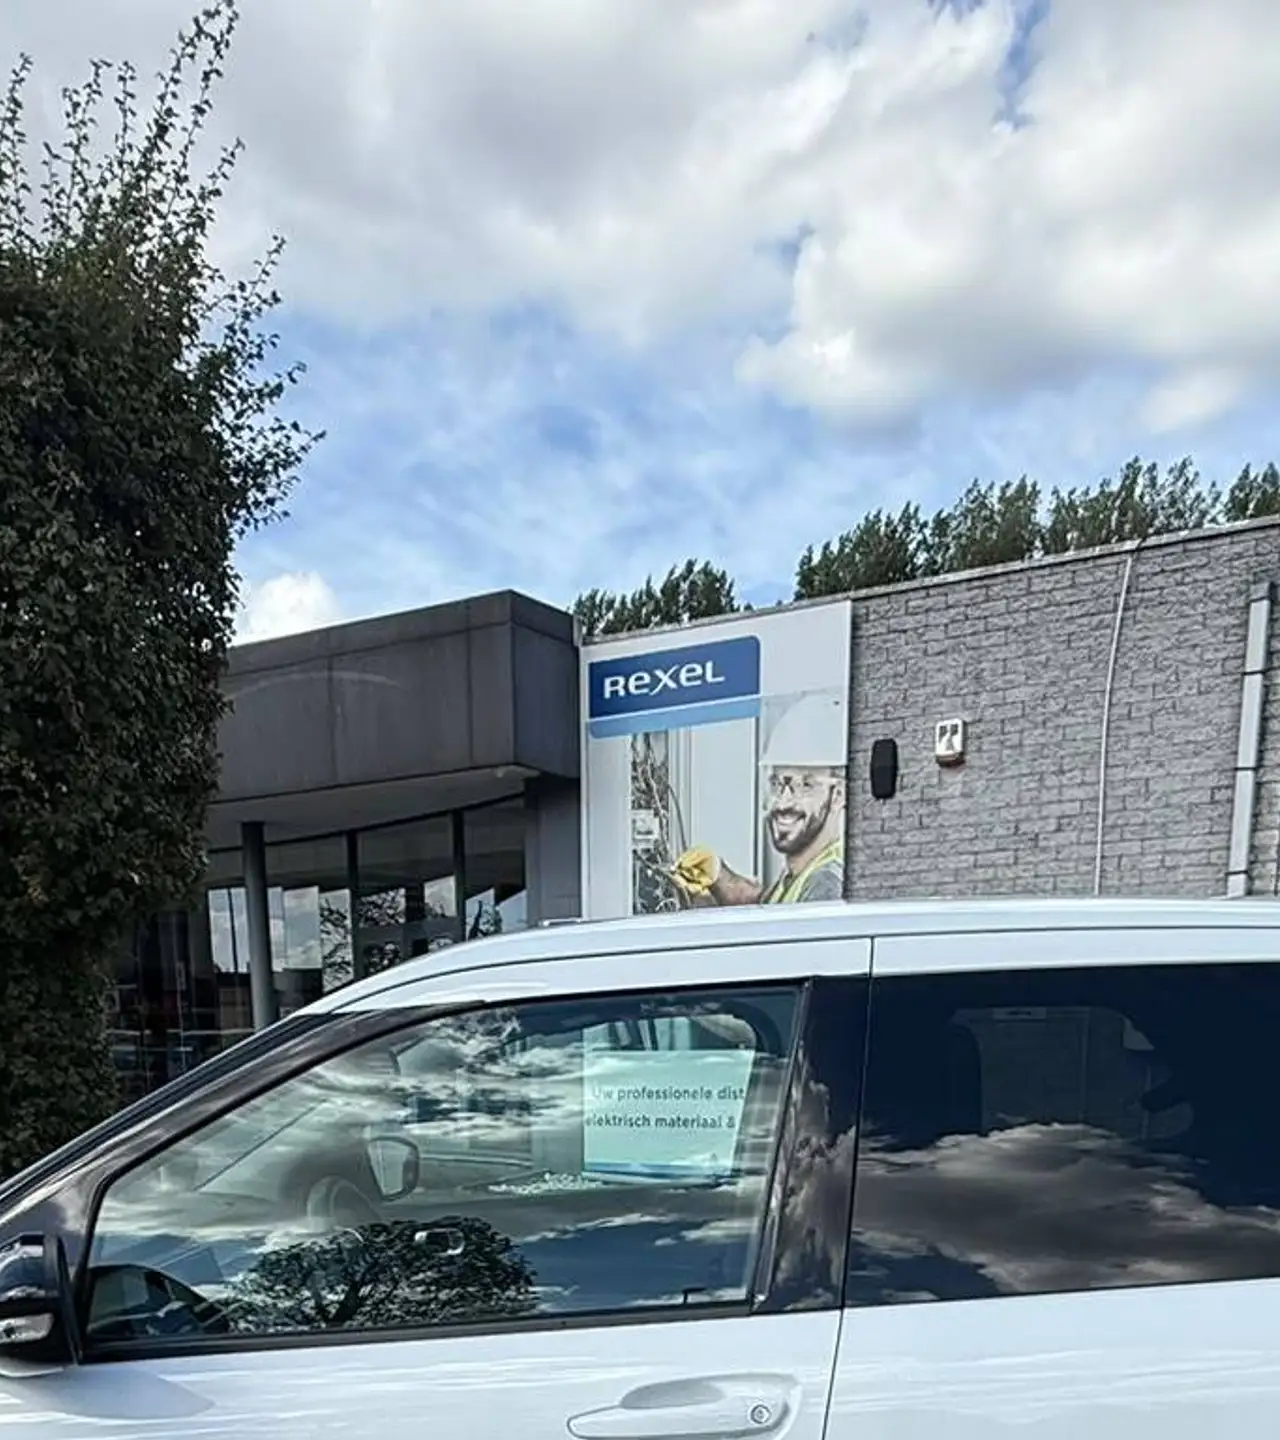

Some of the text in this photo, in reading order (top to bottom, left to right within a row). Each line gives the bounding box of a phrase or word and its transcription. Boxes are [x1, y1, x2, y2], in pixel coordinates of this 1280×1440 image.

[617, 1085, 713, 1101] professionele
[584, 1114, 650, 1128] elektrisch
[654, 1114, 722, 1128] materiaal
